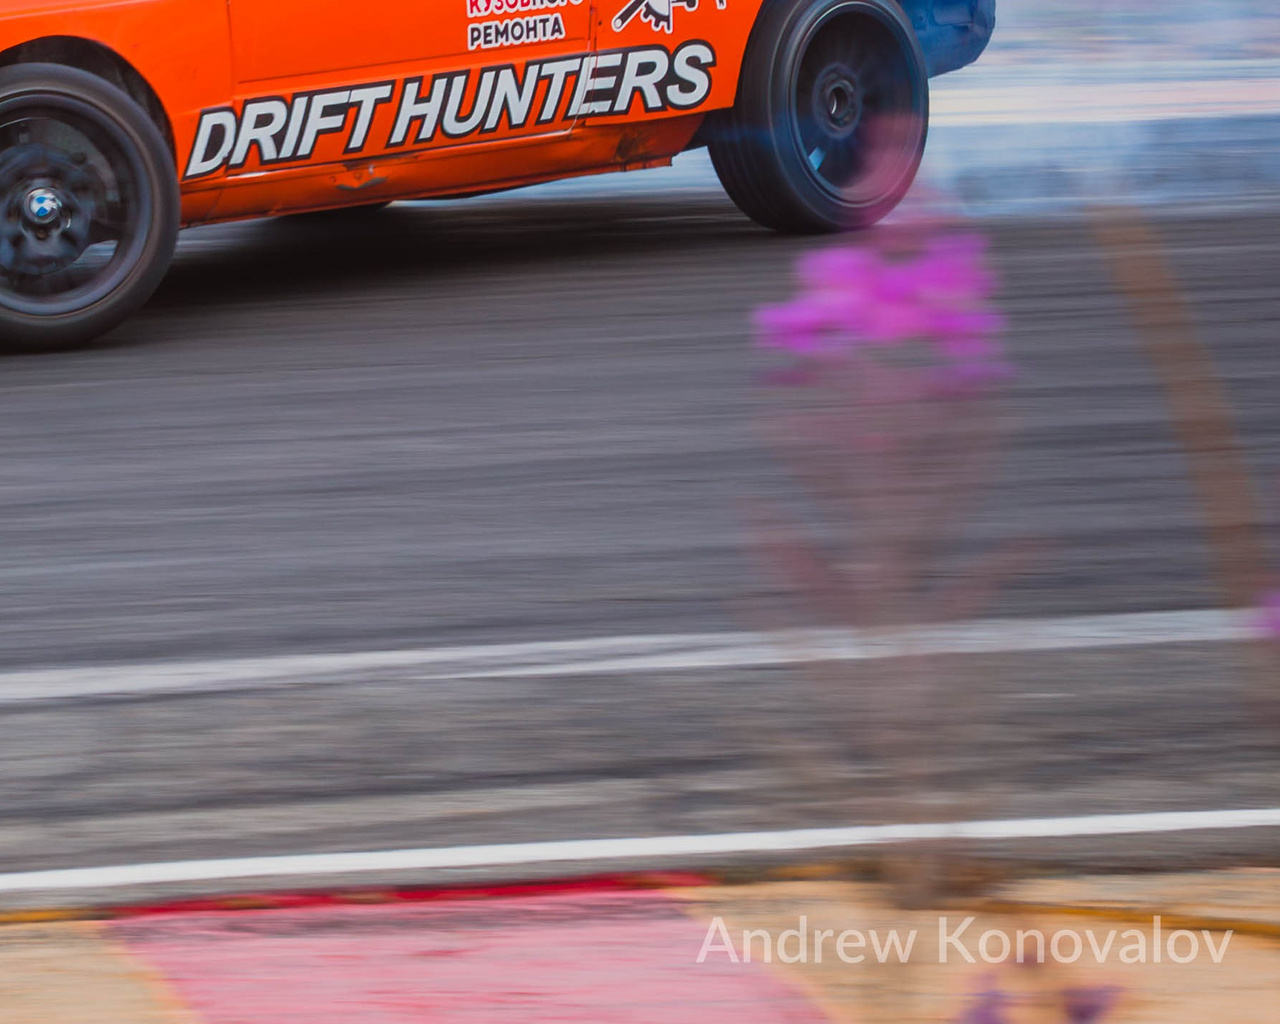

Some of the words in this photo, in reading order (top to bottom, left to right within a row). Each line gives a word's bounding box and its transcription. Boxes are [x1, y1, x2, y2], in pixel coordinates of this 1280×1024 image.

[469, 15, 564, 47] РЕМОНТА
[183, 81, 393, 179] DRIFT
[388, 41, 717, 148] HUNTERS
